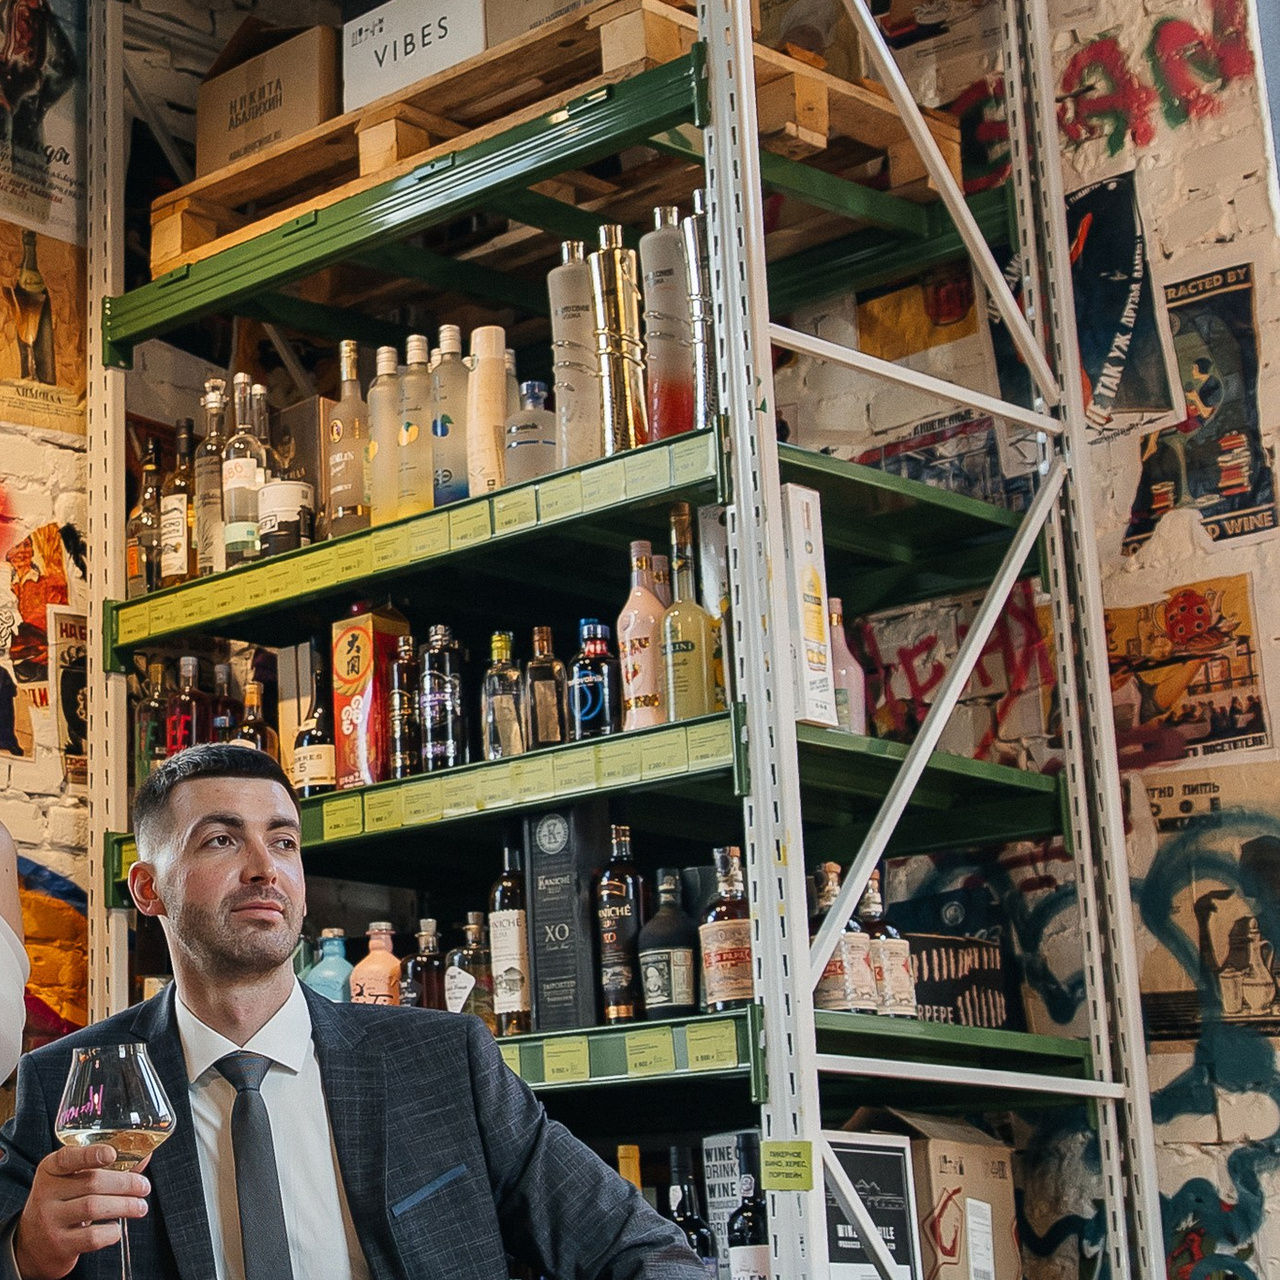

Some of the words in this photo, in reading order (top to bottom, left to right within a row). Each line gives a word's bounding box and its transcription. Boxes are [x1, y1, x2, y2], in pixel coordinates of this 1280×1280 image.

[374, 16, 449, 68] VIBES
[229, 77, 282, 115] НИКИТА
[228, 92, 283, 131] АБАЛИХИН
[1228, 268, 1248, 284] BY
[1096, 363, 1124, 400] ТАК
[1224, 510, 1273, 535] WINE
[298, 762, 307, 773] 5
[544, 923, 570, 943] XO
[917, 1004, 955, 1025] RPEPE
[705, 1147, 733, 1163] WINE
[705, 1163, 738, 1180] DRINK
[707, 1182, 737, 1199] WINE
